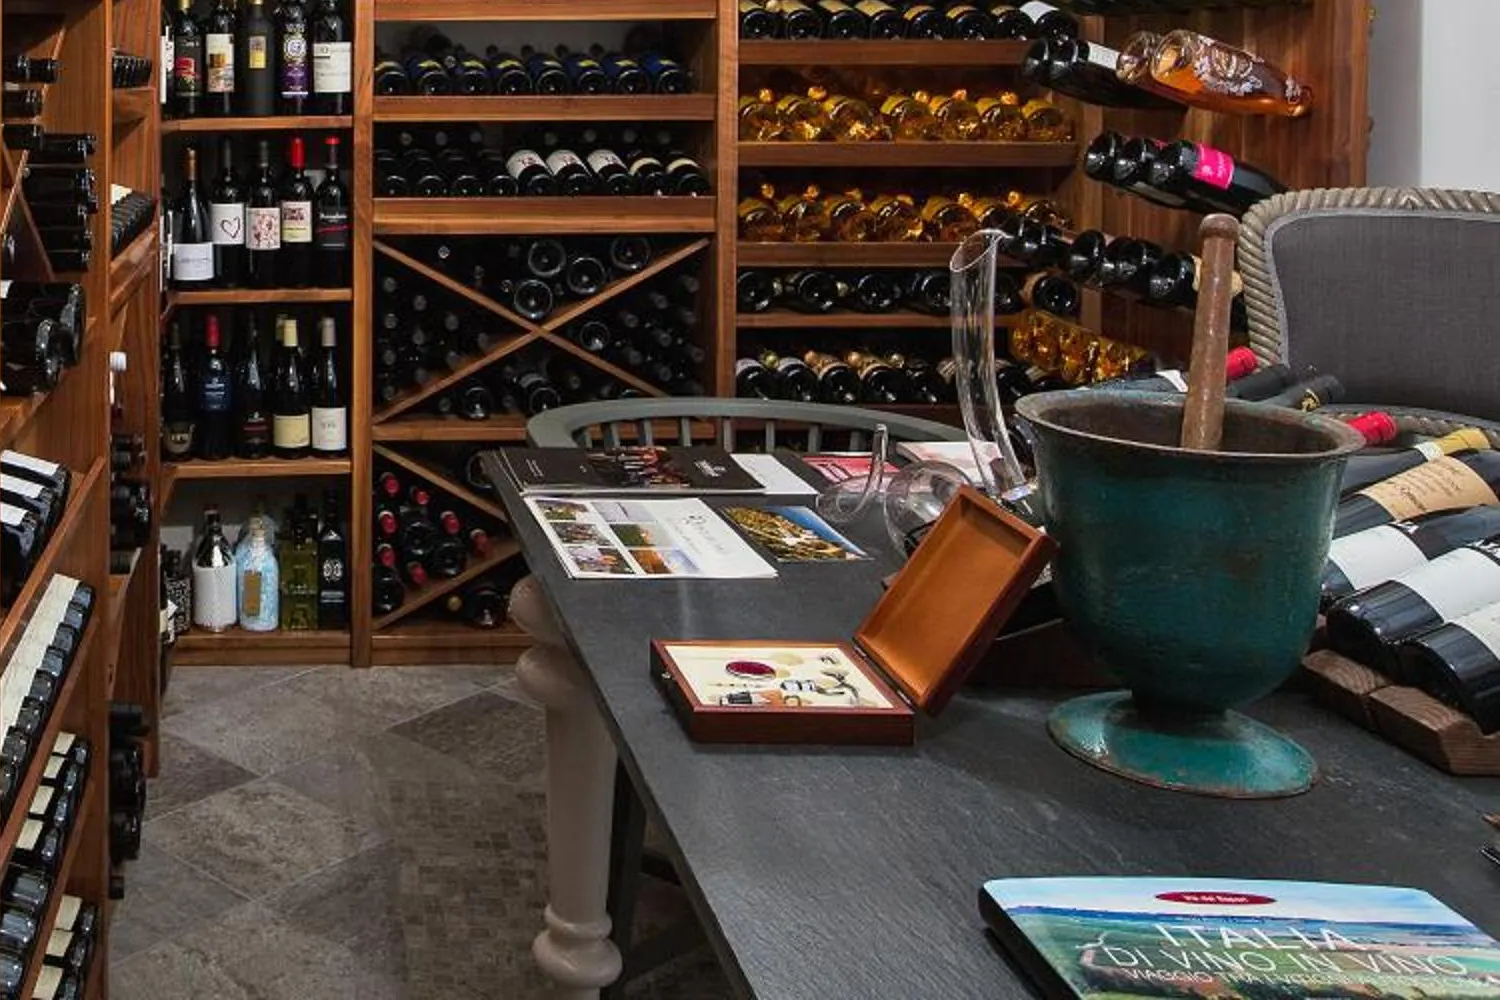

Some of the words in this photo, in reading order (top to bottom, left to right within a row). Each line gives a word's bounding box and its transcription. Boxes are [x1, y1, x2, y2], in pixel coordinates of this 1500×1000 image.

[1153, 922, 1367, 951] ITALIA
[1102, 947, 1155, 968] DI
[1158, 949, 1277, 974] VINO
[1286, 953, 1343, 974] IN
[1343, 953, 1468, 976] VINO
